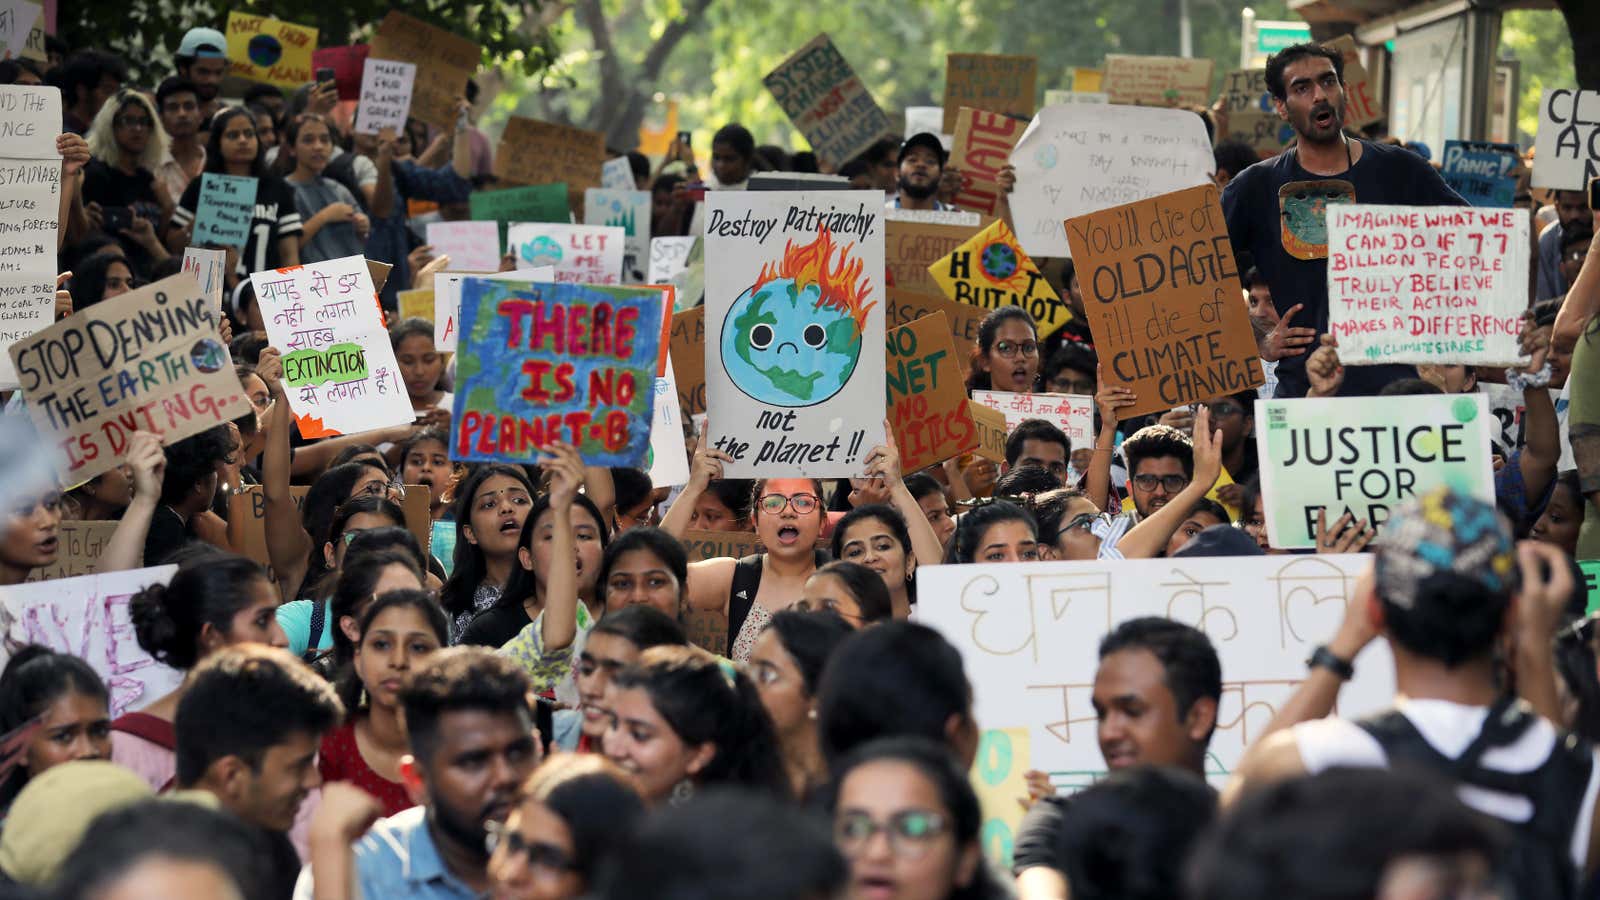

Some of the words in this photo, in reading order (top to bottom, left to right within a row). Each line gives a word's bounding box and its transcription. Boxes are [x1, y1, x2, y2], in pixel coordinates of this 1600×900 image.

[763, 40, 846, 101] SYSTEM
[23, 93, 47, 111] THE
[708, 208, 777, 245] Destroy
[1072, 208, 1142, 256] You'll
[1150, 201, 1184, 243] die
[1191, 189, 1215, 233] of
[1336, 212, 1419, 228] IMAGINE
[1425, 211, 1473, 228] WHAT
[1481, 212, 1514, 228] WE
[571, 233, 608, 250] LET
[1346, 234, 1386, 251] CAN
[1392, 233, 1425, 250] DO
[1437, 233, 1455, 251] IF
[1468, 233, 1508, 255] 7.7
[575, 255, 601, 267] ME
[1093, 253, 1166, 304] OLD
[1170, 236, 1238, 288] AGE
[1332, 252, 1415, 271] BILLION
[1423, 252, 1503, 272] PEOPLE
[310, 271, 332, 297] से
[338, 272, 361, 293] डर
[1334, 276, 1404, 296] TRULY
[1410, 273, 1493, 293] BELIEVE
[316, 300, 358, 323] लगता
[955, 281, 1006, 309] BUT
[1011, 293, 1062, 324] NOT
[1145, 302, 1189, 341] die
[1200, 288, 1225, 323] of
[1342, 297, 1403, 311] THEIR
[1413, 295, 1478, 310] ACTION
[498, 298, 640, 360] THERE
[1331, 318, 1386, 338] MAKES
[1393, 316, 1404, 330] A
[1408, 313, 1526, 338] DIFFERENCE
[18, 329, 84, 392] STOP
[286, 350, 366, 382] EXTINCTION
[1112, 330, 1226, 382] CLIMATE
[38, 387, 97, 430] THE
[98, 351, 190, 407] EARTH
[300, 383, 320, 405] से
[327, 377, 368, 402] लगता
[521, 359, 575, 403] IS
[589, 367, 635, 408] NO
[1159, 356, 1265, 404] CHANGE
[756, 410, 797, 432] not
[58, 433, 99, 472] IS
[714, 435, 750, 460] the
[753, 435, 841, 466] planet
[1283, 424, 1466, 467] JUSTICE
[1335, 468, 1416, 500] FOR
